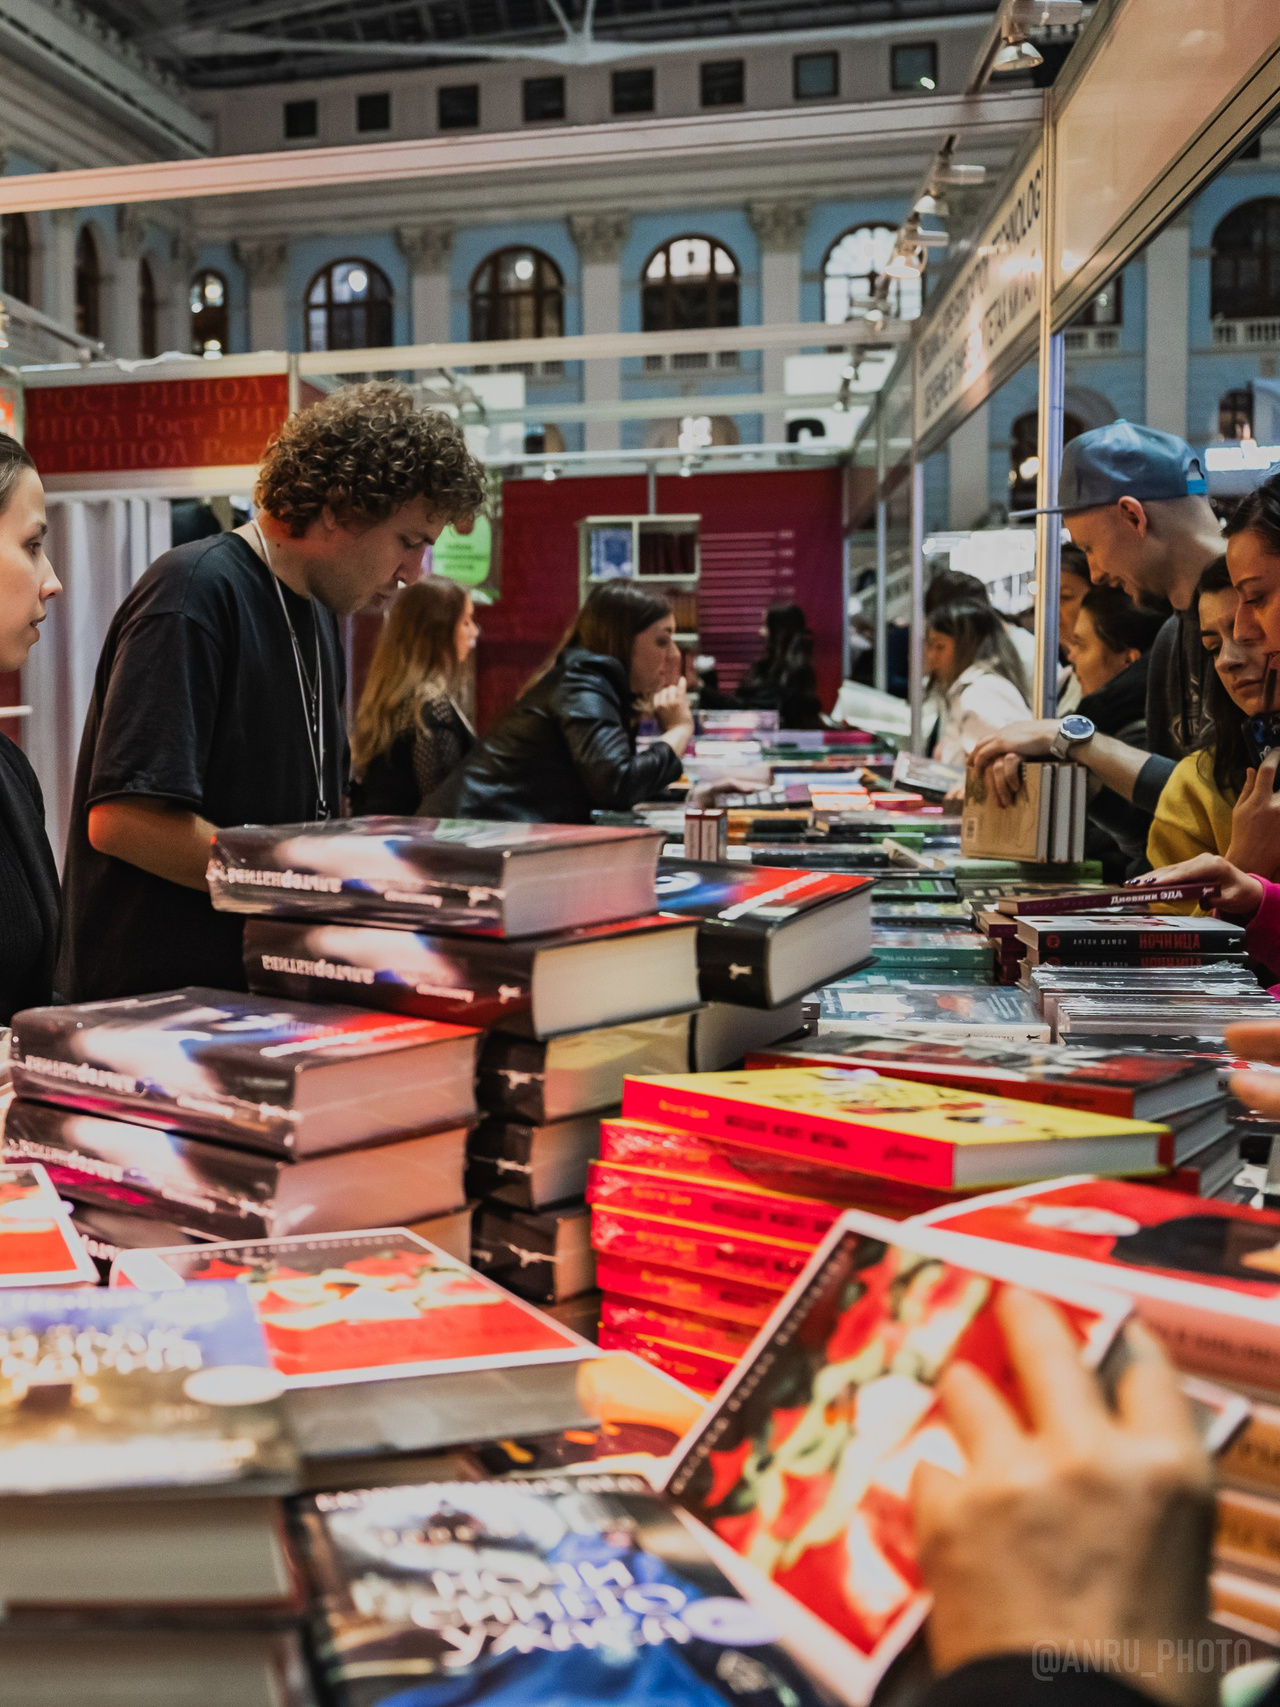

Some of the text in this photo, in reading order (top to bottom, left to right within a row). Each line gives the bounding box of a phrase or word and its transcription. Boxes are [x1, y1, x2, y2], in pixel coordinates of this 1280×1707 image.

[139, 377, 265, 408] РИПОЛ
[66, 439, 189, 471] РИПОЛ
[1110, 892, 1158, 906] Дневник
[1160, 888, 1184, 901] ЭДА
[1138, 932, 1201, 950] НОЧНИЦА
[260, 954, 376, 985] альтернатива
